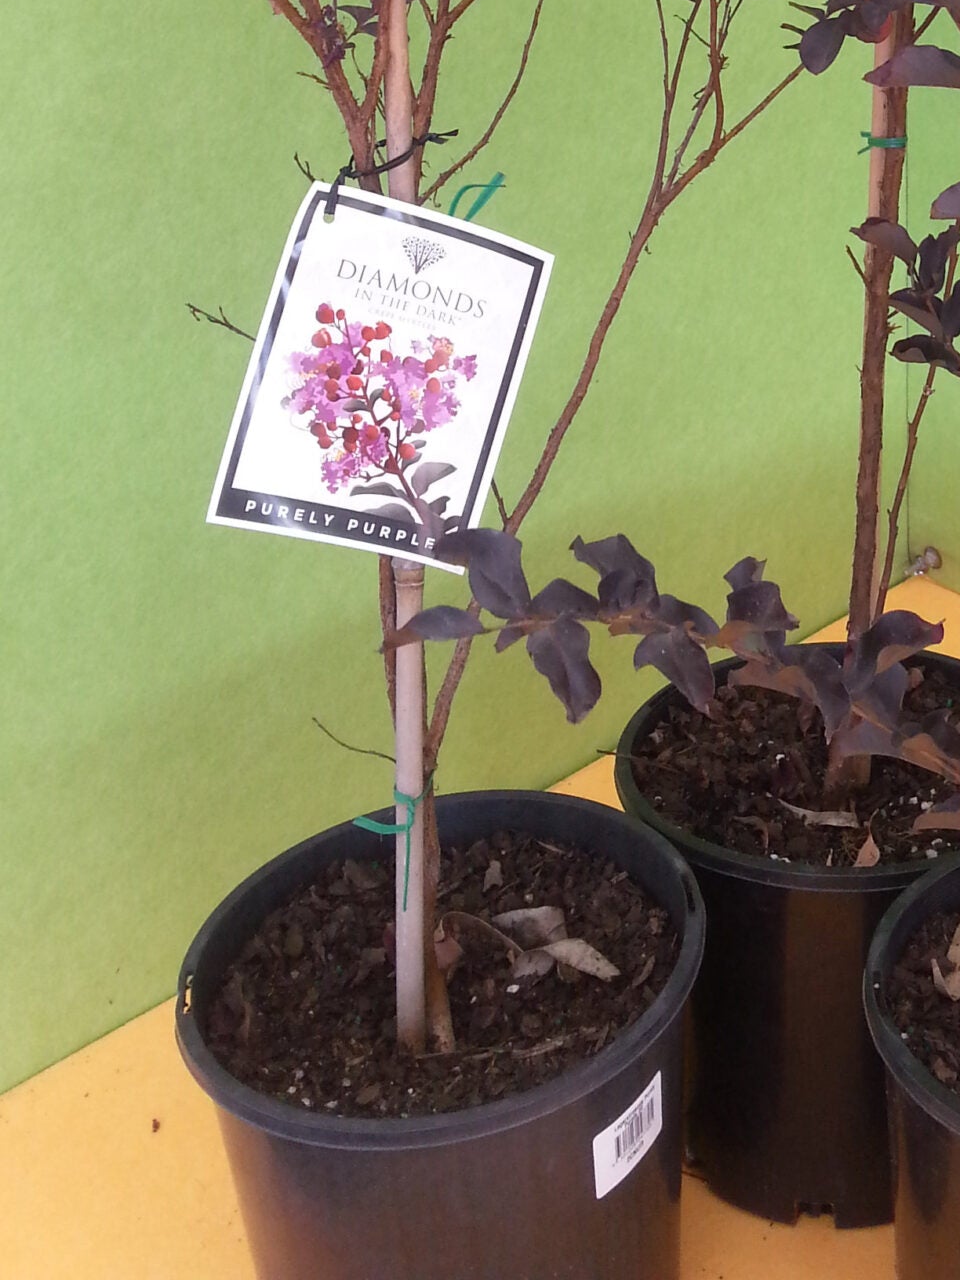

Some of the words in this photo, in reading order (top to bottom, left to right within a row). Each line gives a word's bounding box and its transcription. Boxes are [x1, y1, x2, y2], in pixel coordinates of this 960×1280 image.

[337, 259, 488, 319] DIAMONDS
[355, 287, 373, 302] IN
[416, 304, 457, 326] DARK
[245, 499, 335, 527] PURELY
[347, 518, 436, 550] PURPLE
